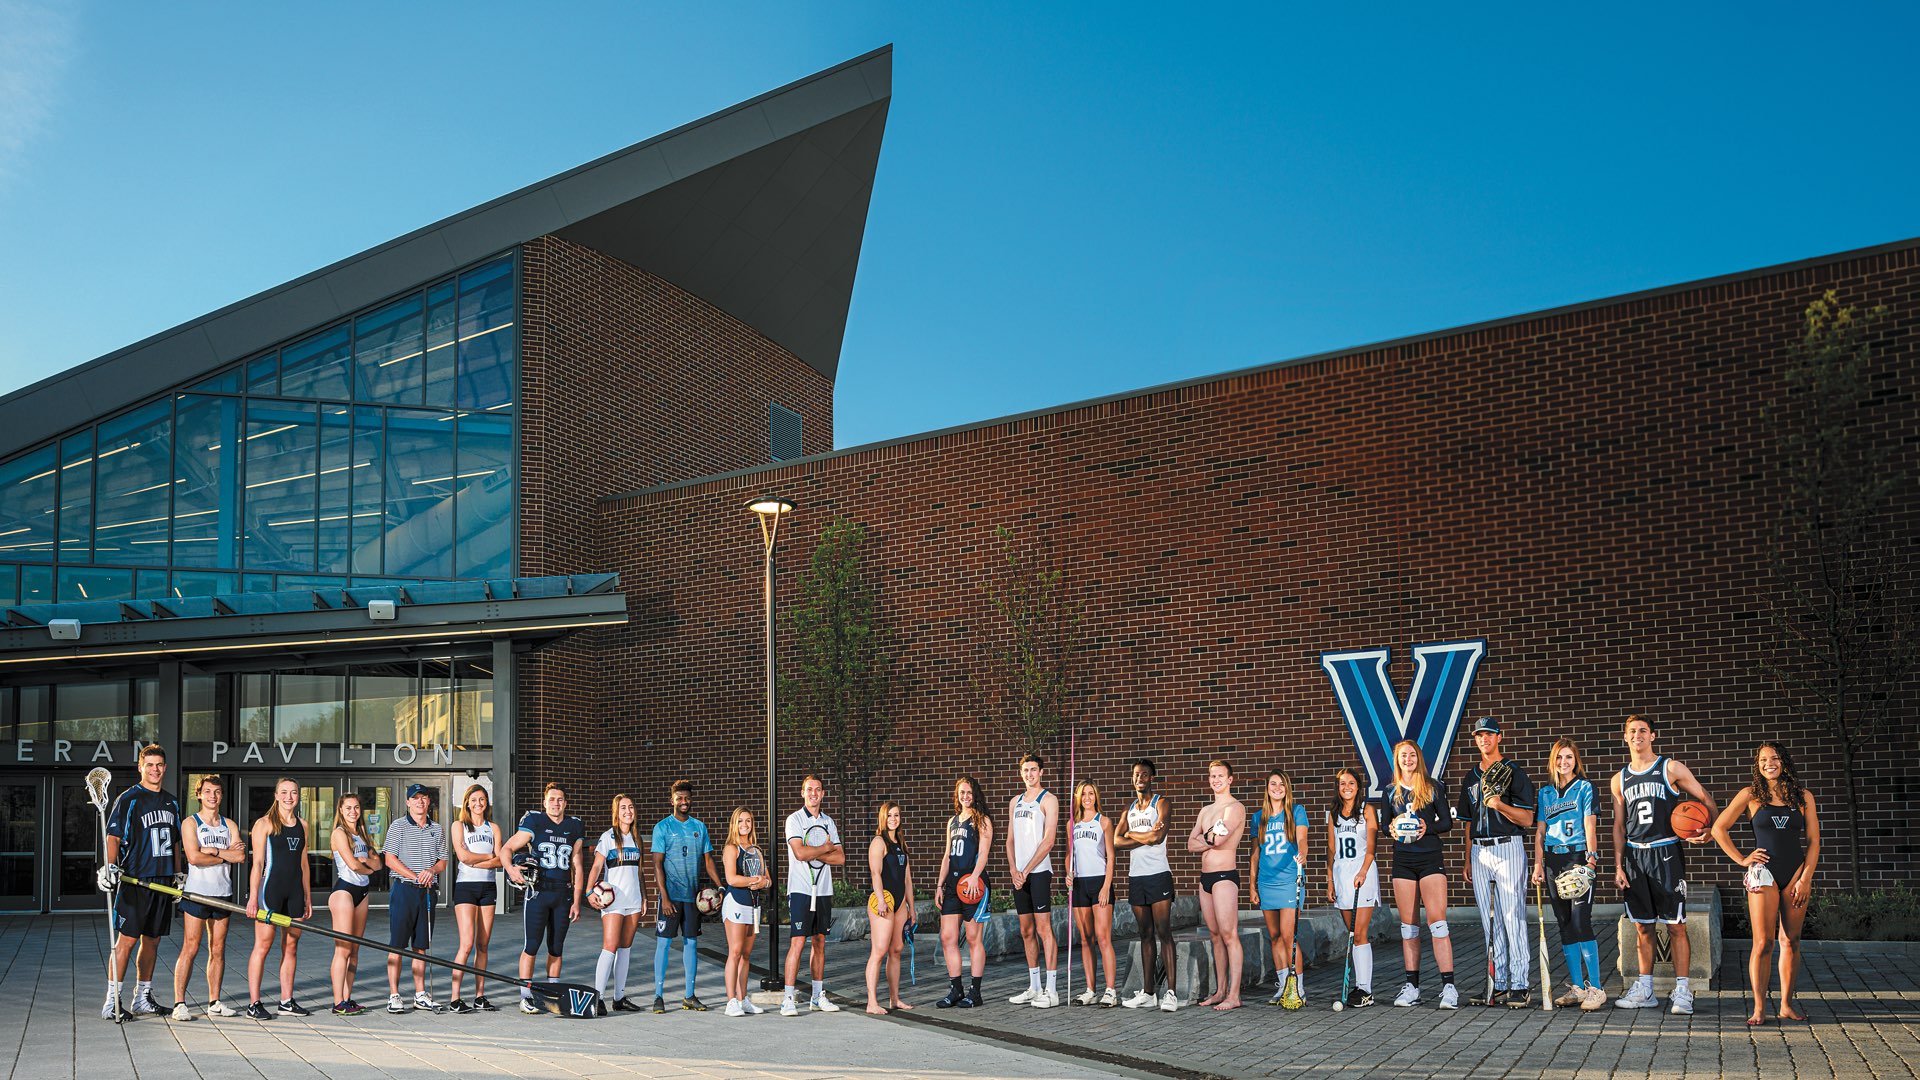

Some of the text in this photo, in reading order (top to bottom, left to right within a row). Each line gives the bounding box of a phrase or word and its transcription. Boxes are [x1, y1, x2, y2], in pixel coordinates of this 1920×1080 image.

[1320, 638, 1487, 801] V
[212, 741, 453, 765] PAVILION
[1624, 782, 1667, 805] VILLANOVA
[141, 810, 174, 829] VILLANOV
[1637, 801, 1653, 825] 2
[1771, 816, 1789, 829] V
[467, 835, 493, 845] VILLANOVA
[1336, 825, 1358, 835] VILLANOVA
[1565, 822, 1574, 837] 5
[150, 827, 173, 858] 12
[287, 837, 300, 851] V
[681, 845, 689, 858] 9
[1265, 831, 1288, 856] 22
[1339, 837, 1357, 860] 18
[538, 842, 573, 870] 38
[568, 988, 595, 1016] V
